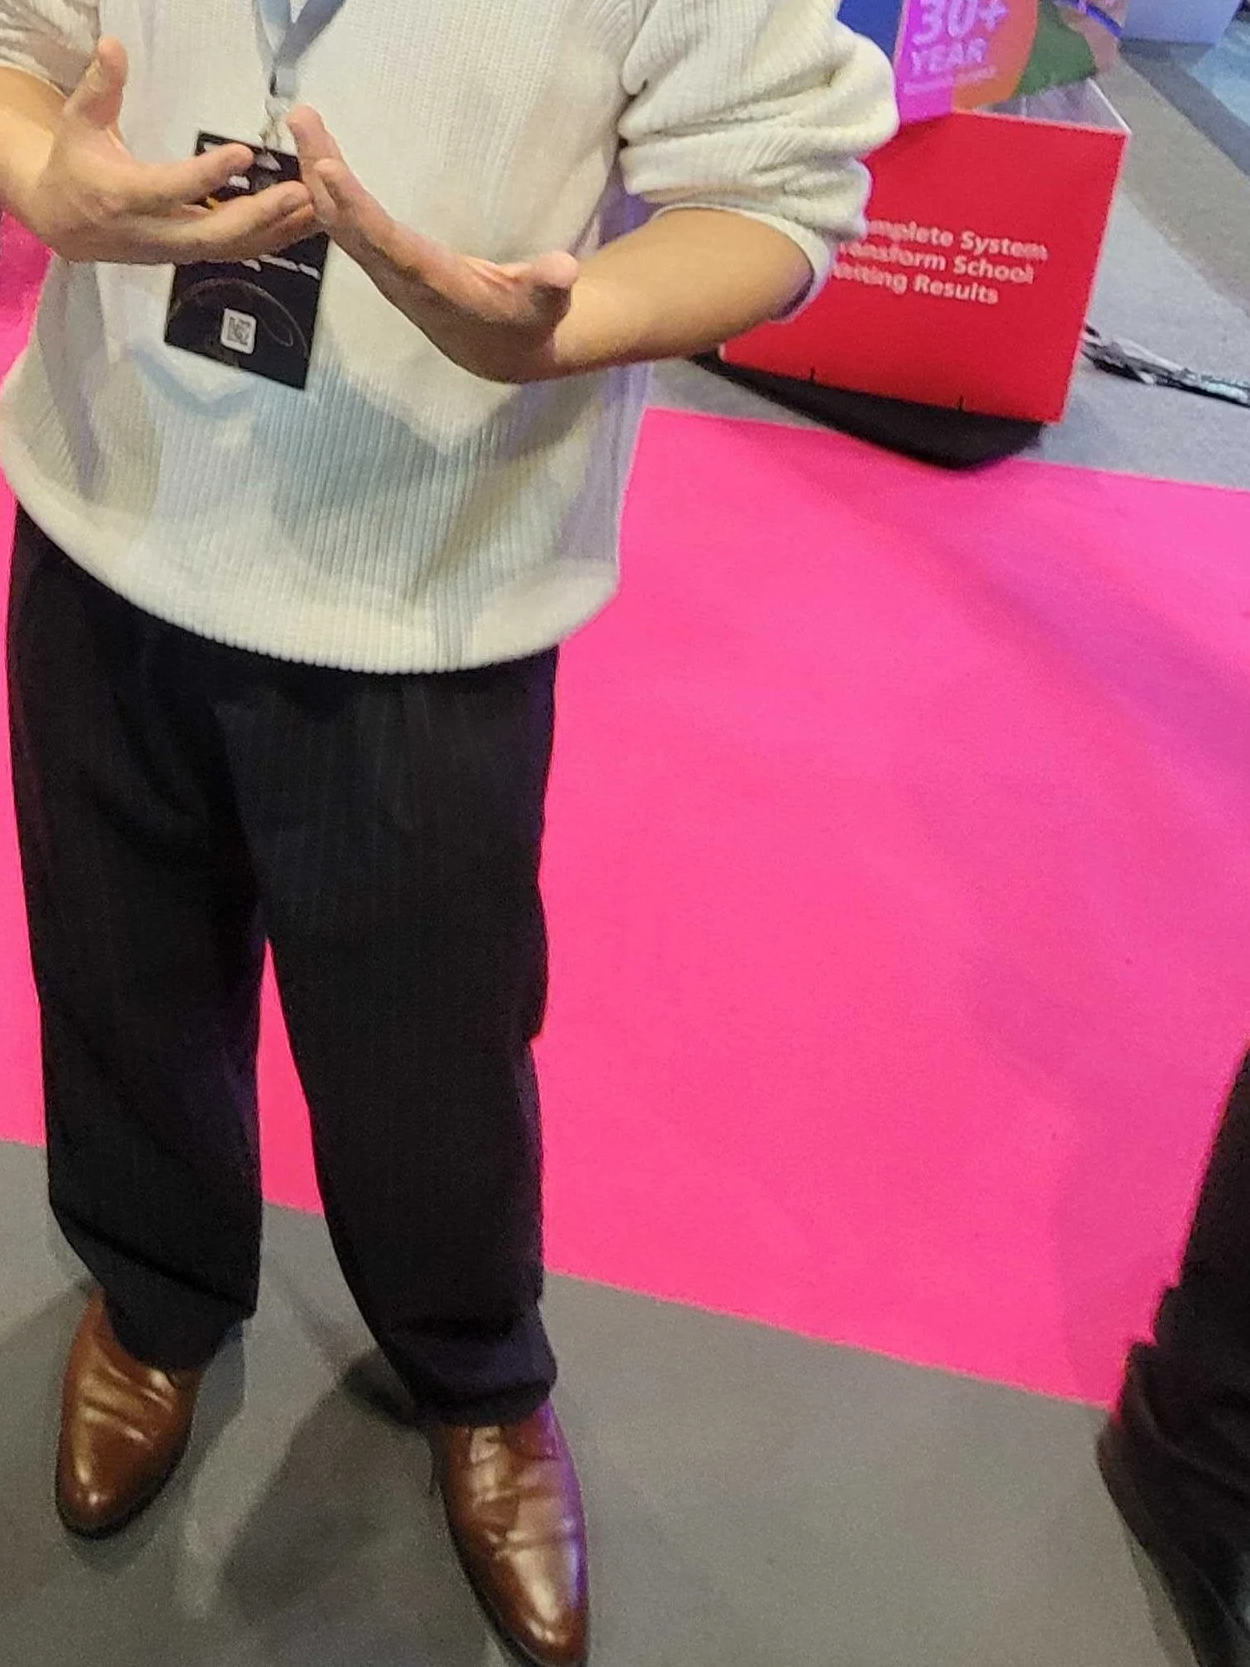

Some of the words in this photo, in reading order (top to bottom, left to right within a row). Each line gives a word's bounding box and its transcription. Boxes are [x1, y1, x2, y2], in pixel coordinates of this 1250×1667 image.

[959, 229, 1049, 262] System
[952, 254, 1035, 284] School
[912, 273, 999, 305] Results
